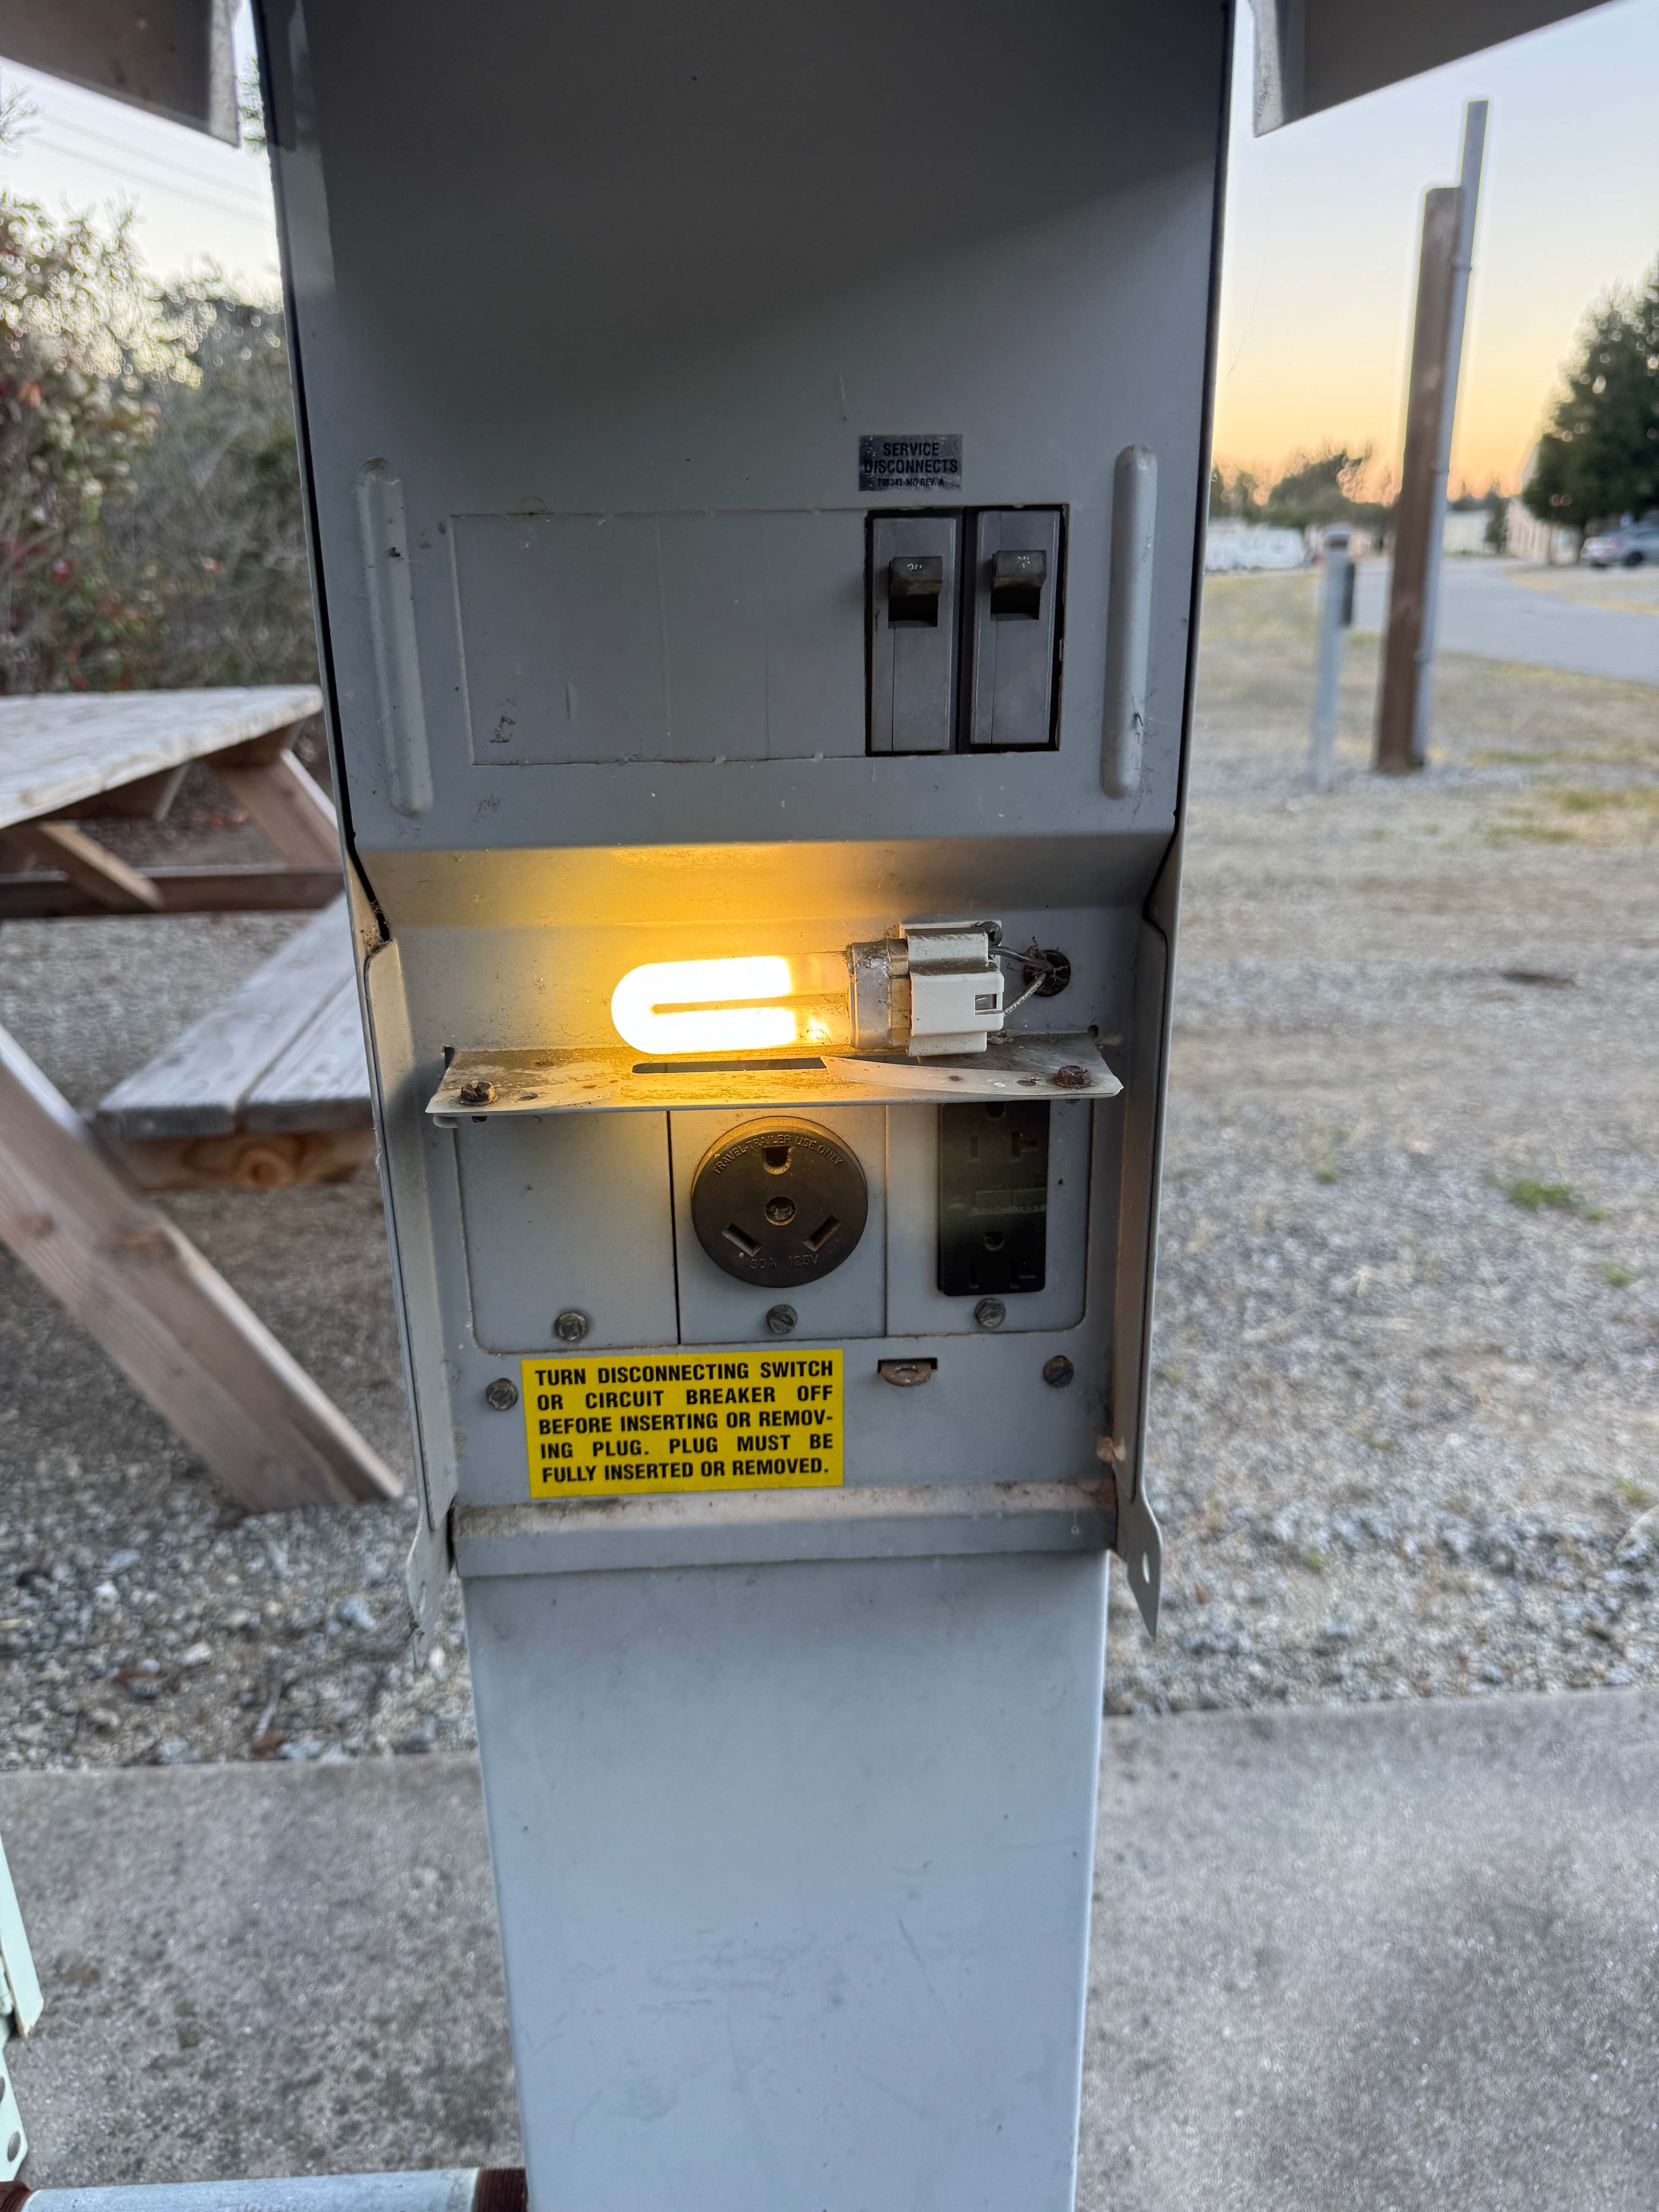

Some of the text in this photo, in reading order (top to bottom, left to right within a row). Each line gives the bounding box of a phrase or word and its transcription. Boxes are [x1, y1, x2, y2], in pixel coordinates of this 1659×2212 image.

[883, 442, 939, 456] SERVICE
[864, 459, 957, 473] DISCONNECTS
[920, 478, 936, 486] REV.
[795, 1136, 817, 1149] USE
[818, 1145, 843, 1164] ONLY
[750, 1254, 818, 1269] 30A 125V
[535, 1360, 833, 1386] TURN DISCONNECTING SWITCH
[537, 1385, 833, 1411] OR CIRCUIT BREAKER OFF
[539, 1409, 833, 1435] BEFORE INSERTING OR REMOV-
[541, 1433, 833, 1459] ING PLUG. PLUG MUST BE
[543, 1458, 828, 1483] FULLY INSERTED OR REMOVED.
